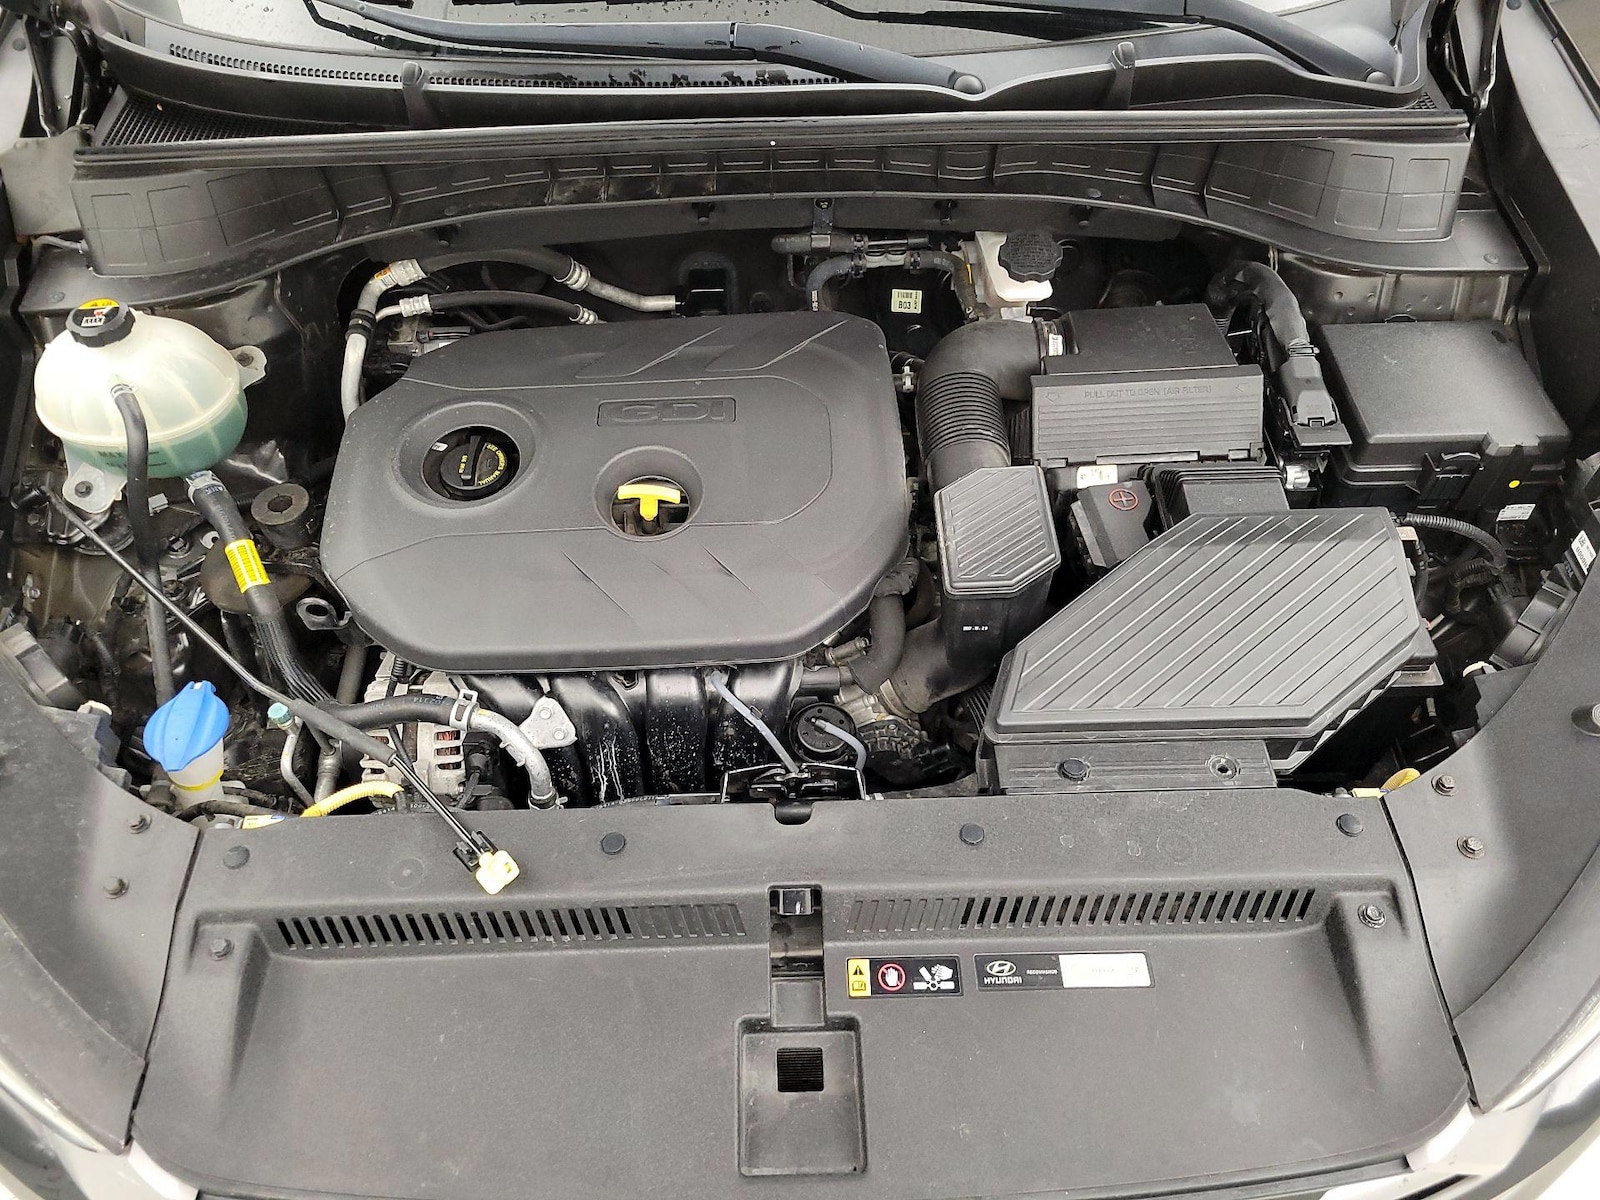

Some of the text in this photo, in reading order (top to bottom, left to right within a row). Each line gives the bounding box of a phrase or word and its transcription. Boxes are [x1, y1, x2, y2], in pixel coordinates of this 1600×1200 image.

[898, 300, 912, 310] B03
[1084, 389, 1105, 399] PULL
[1106, 388, 1124, 398] OUT
[612, 401, 726, 423] GDI
[983, 975, 1023, 985] HYUNDAI
